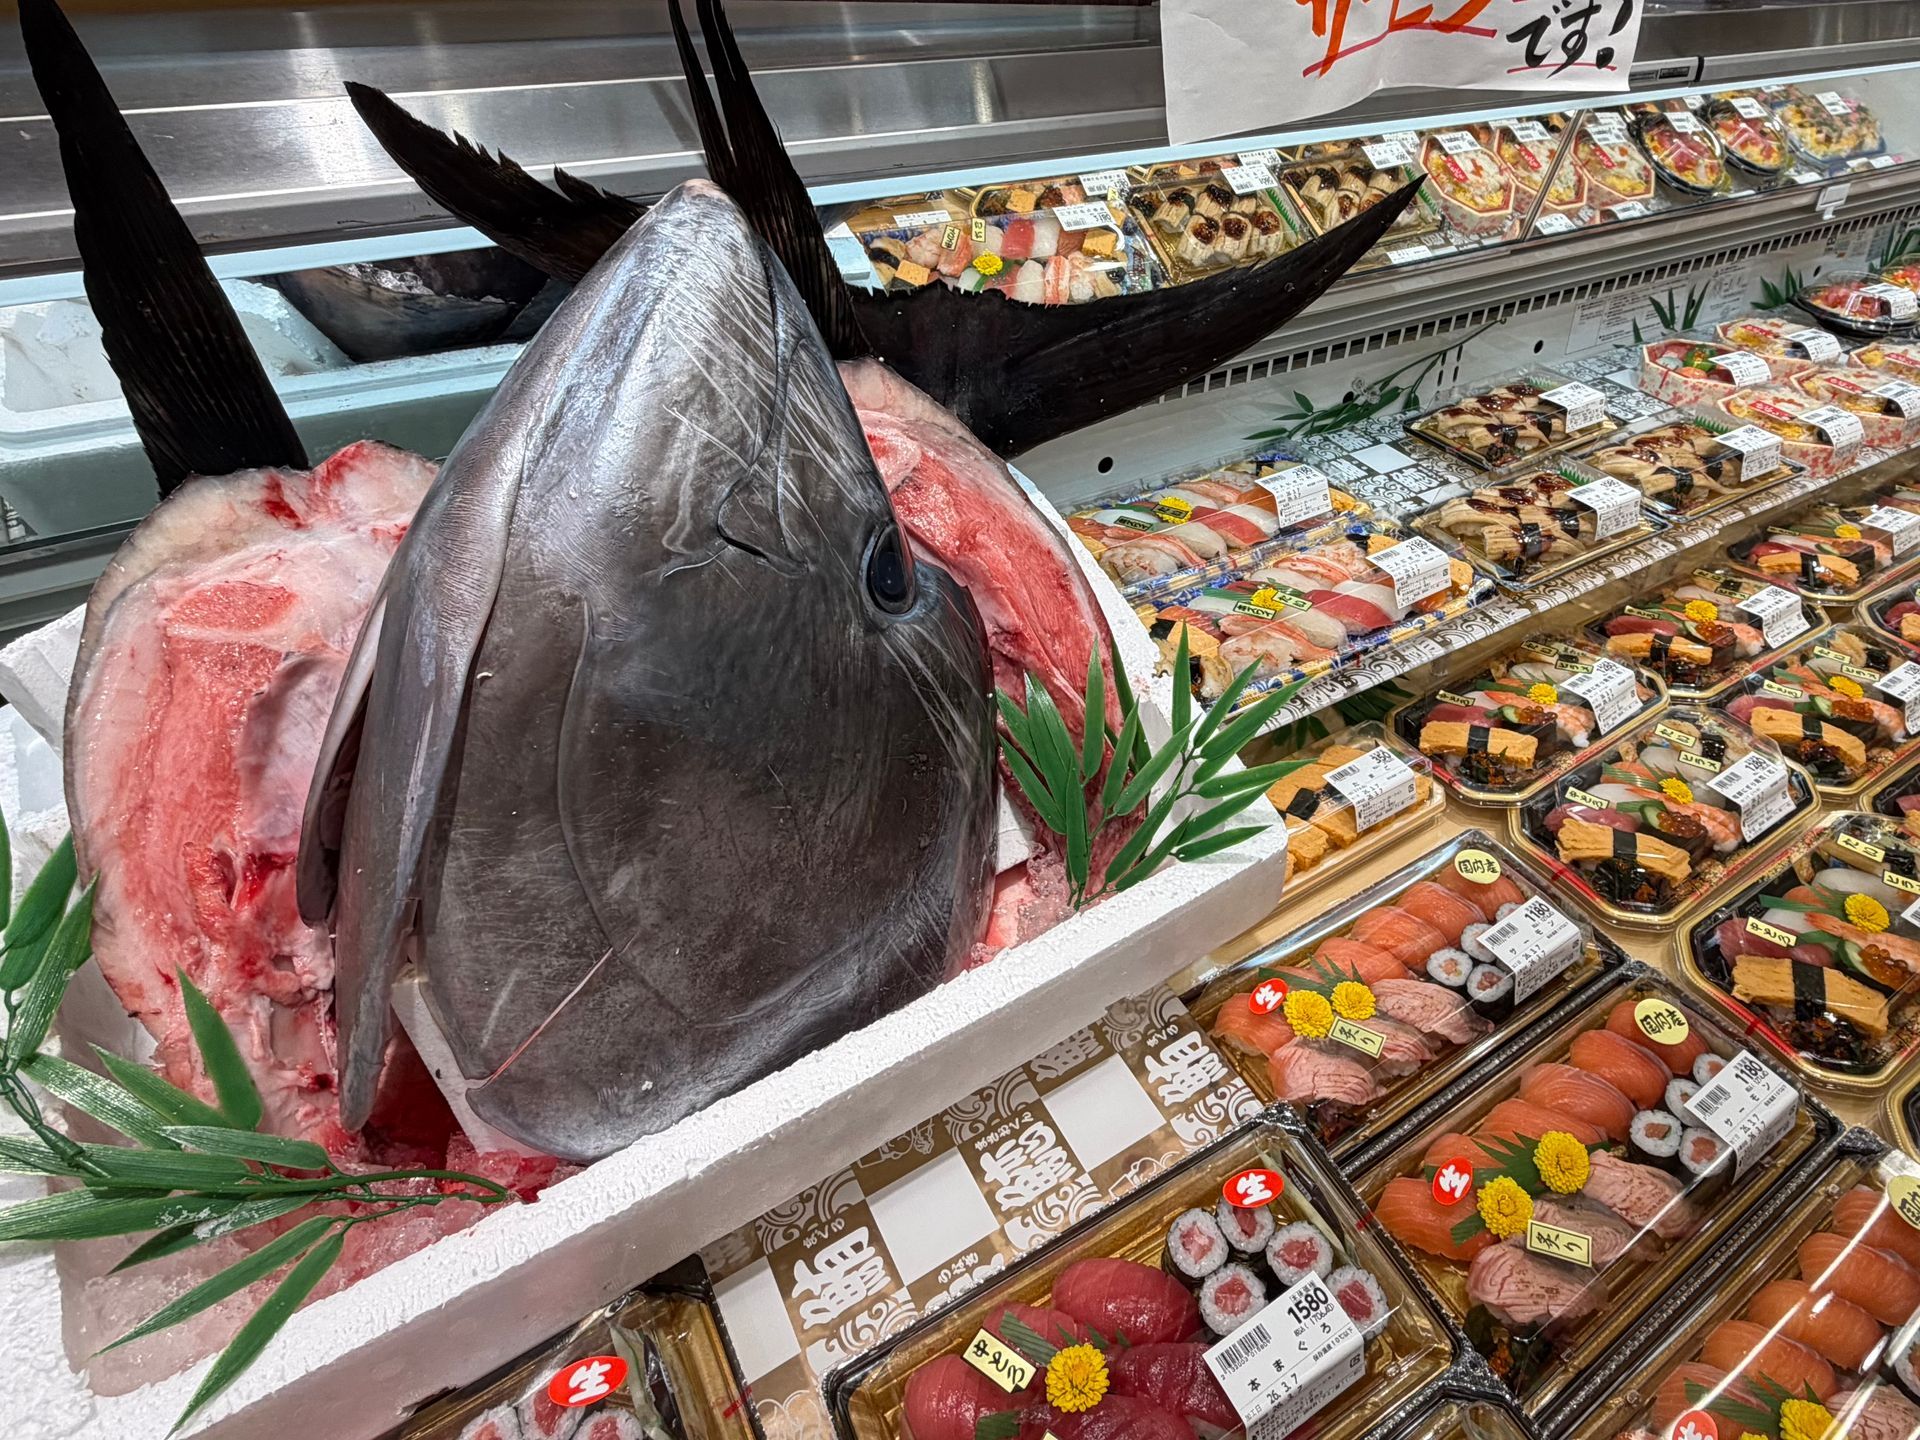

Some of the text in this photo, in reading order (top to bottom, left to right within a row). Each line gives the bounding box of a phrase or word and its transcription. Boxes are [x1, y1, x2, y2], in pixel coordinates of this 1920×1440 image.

[1844, 665, 1879, 682] ヒラメ
[1659, 727, 1691, 745] たい
[1681, 753, 1719, 771] ヒラメ
[1567, 787, 1607, 808] 中とろ
[1841, 837, 1878, 858] たい
[1457, 858, 1500, 875] 国内産
[1524, 902, 1551, 923] 1180
[1749, 921, 1792, 946] 中とろ
[1255, 983, 1283, 1010] 生
[1145, 1023, 1179, 1048] まぐろ
[1642, 1007, 1687, 1037] 国内産
[1338, 1025, 1377, 1047] 炙り
[1144, 1031, 1228, 1107] 鮪
[1734, 1059, 1764, 1085] 1180
[1723, 1081, 1771, 1128] サーモン
[1236, 1172, 1273, 1206] 生
[1439, 1164, 1470, 1199] 生
[802, 1217, 846, 1249] まぐろ
[1535, 1231, 1584, 1253] 炙り
[791, 1226, 893, 1330] 鮪
[937, 1252, 980, 1285] うなぎ
[1287, 1286, 1329, 1325] 1580
[971, 1338, 1026, 1386] 中とろ
[1247, 1322, 1333, 1393] 本まぐろ
[568, 1360, 613, 1405] 生
